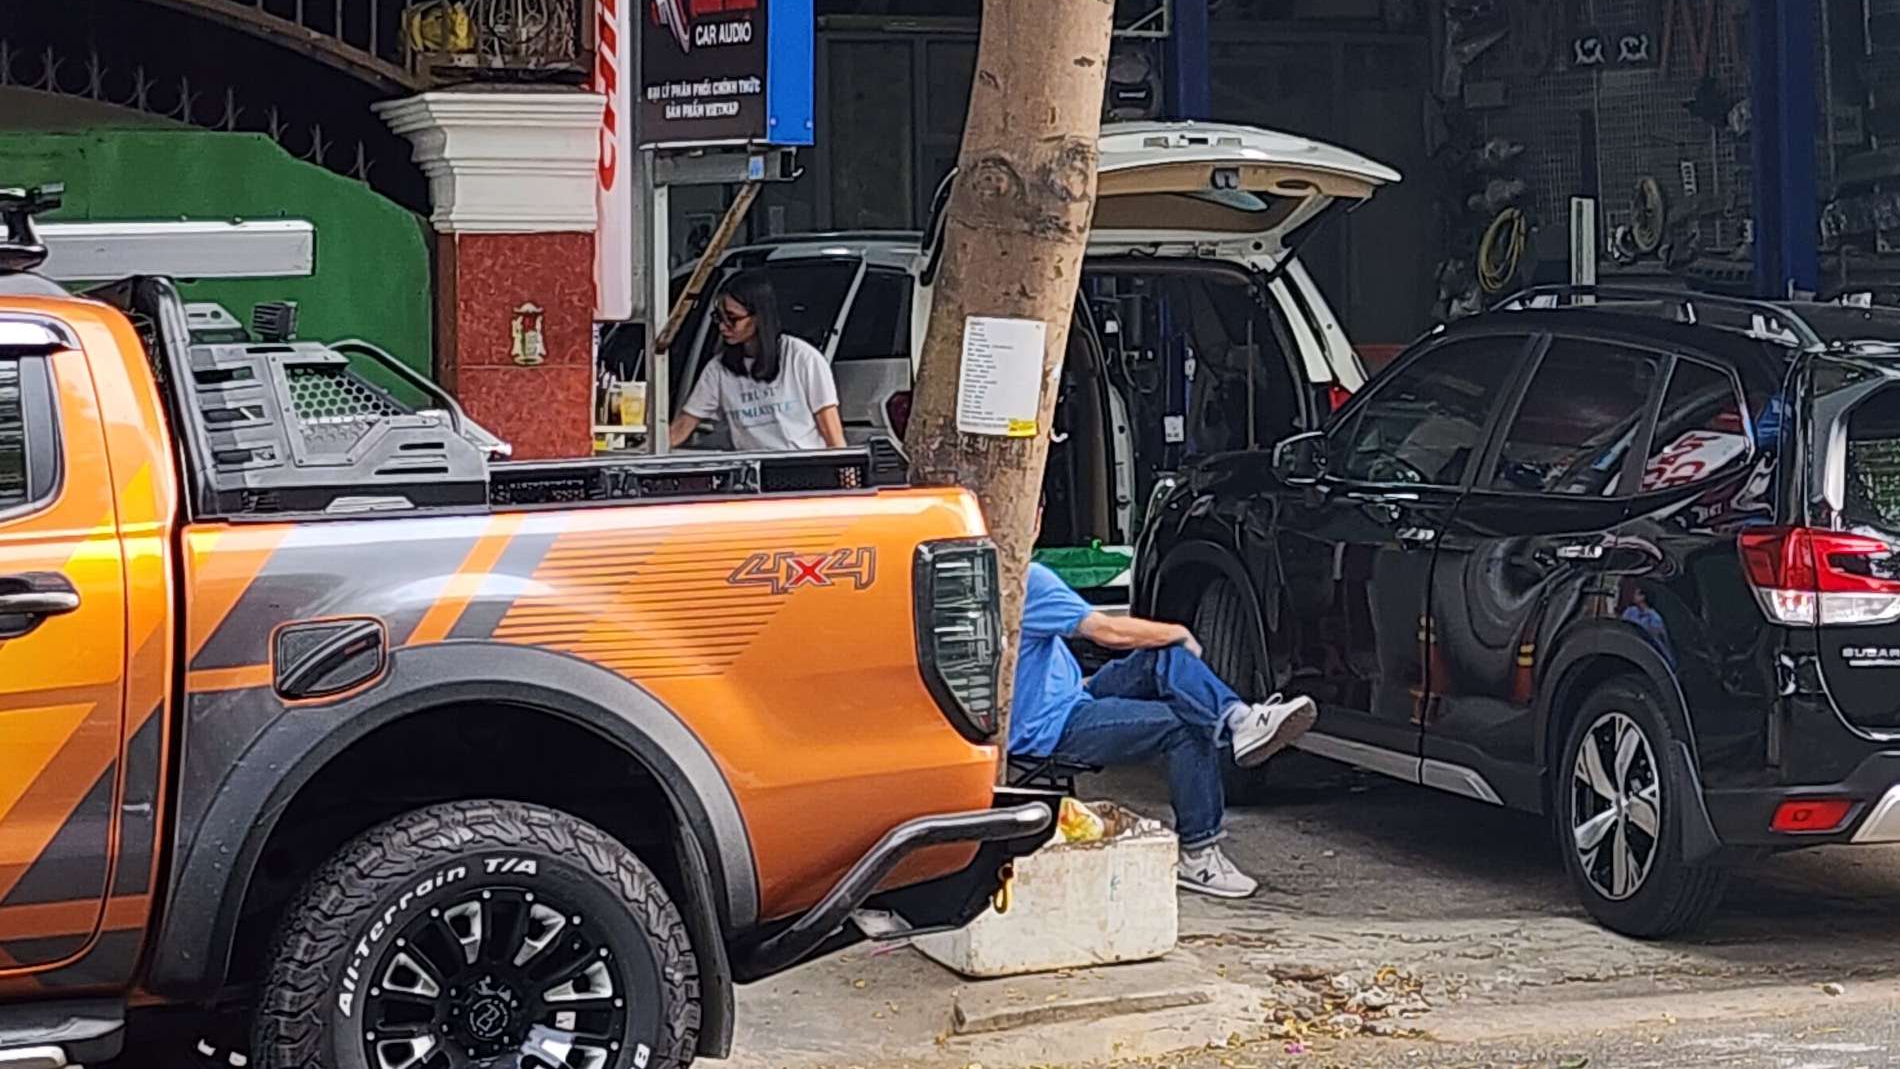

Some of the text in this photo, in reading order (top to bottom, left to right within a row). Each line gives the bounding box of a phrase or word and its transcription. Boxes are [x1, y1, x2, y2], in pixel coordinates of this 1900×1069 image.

[695, 22, 751, 46] CAR AUDIO
[483, 857, 538, 876] T/A
